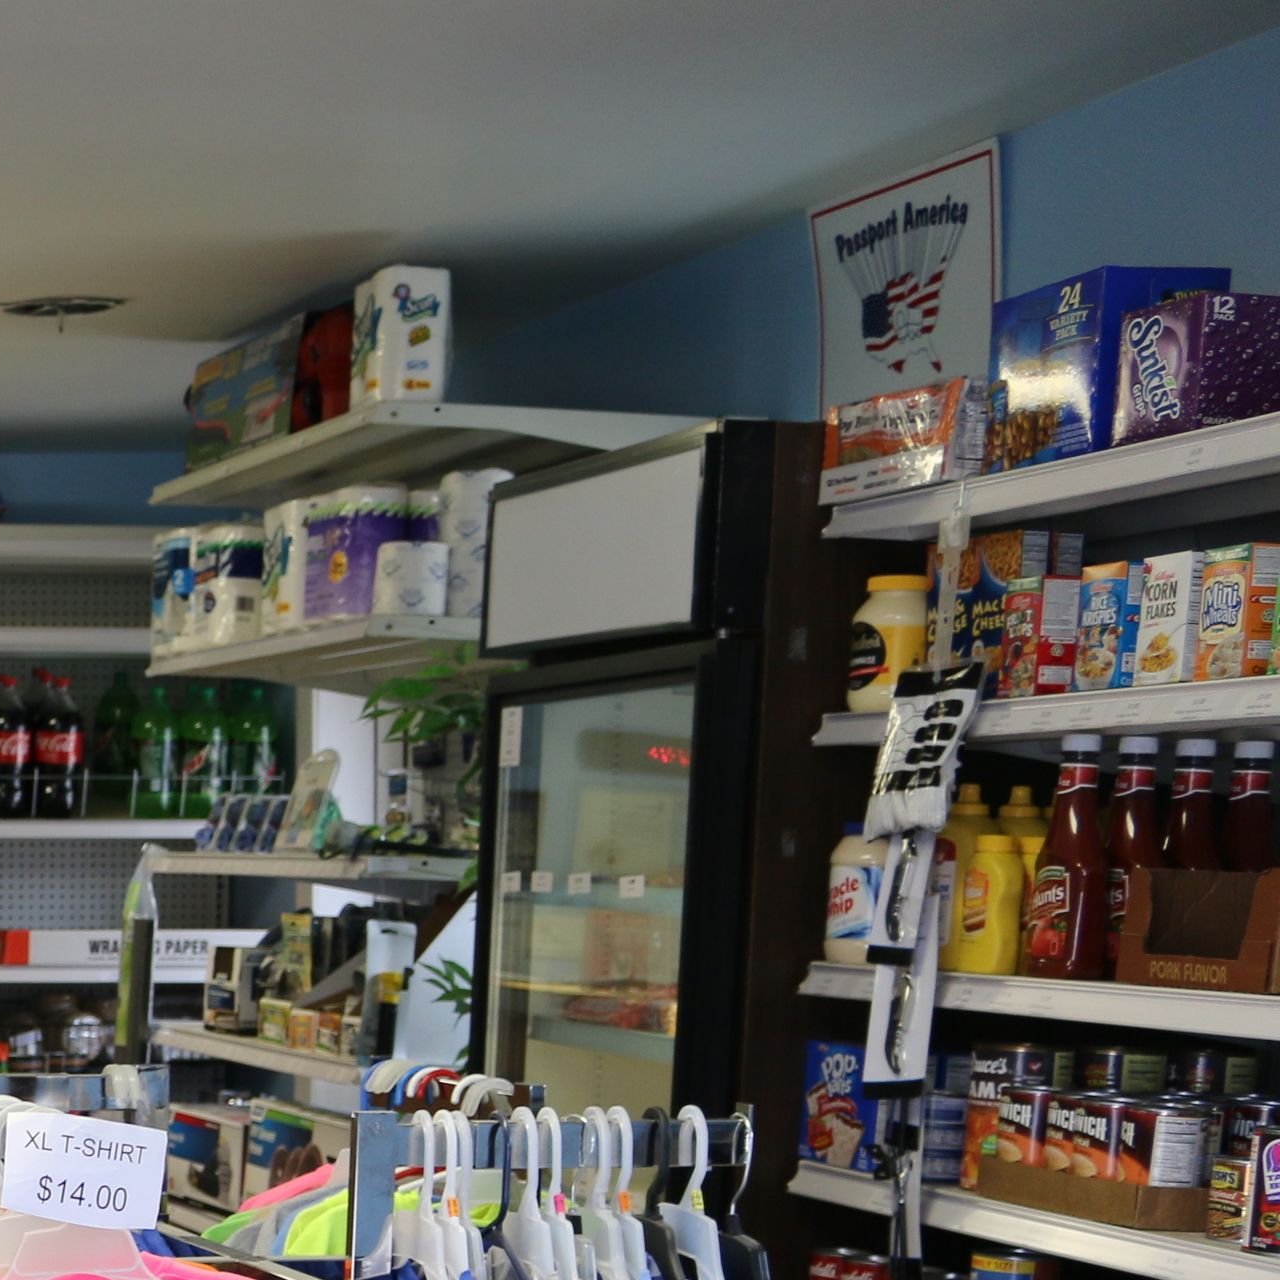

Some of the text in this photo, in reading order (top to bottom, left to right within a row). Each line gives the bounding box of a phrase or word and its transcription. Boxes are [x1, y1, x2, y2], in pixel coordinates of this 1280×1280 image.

[834, 194, 969, 263] Passport America
[1058, 282, 1082, 314] 24
[1212, 296, 1235, 313] 12
[1050, 310, 1088, 330] VARIETY
[1213, 313, 1235, 321] PACK
[1055, 325, 1078, 341] PACK
[1127, 315, 1181, 421] Sunkist
[1132, 384, 1147, 416] Grape
[1147, 582, 1178, 602] CORN
[1204, 582, 1240, 608] Mini
[972, 599, 998, 617] MAC
[1091, 595, 1109, 610] RICE
[1146, 602, 1176, 620] FLAKES
[1082, 609, 1117, 627] KRISPIES
[1202, 606, 1237, 633] Wheats
[166, 940, 209, 955] PAPER
[1150, 960, 1228, 984] PORK FLAVOR
[24, 1130, 147, 1165] XL T-SHIRT
[36, 1174, 129, 1212] $14.00
